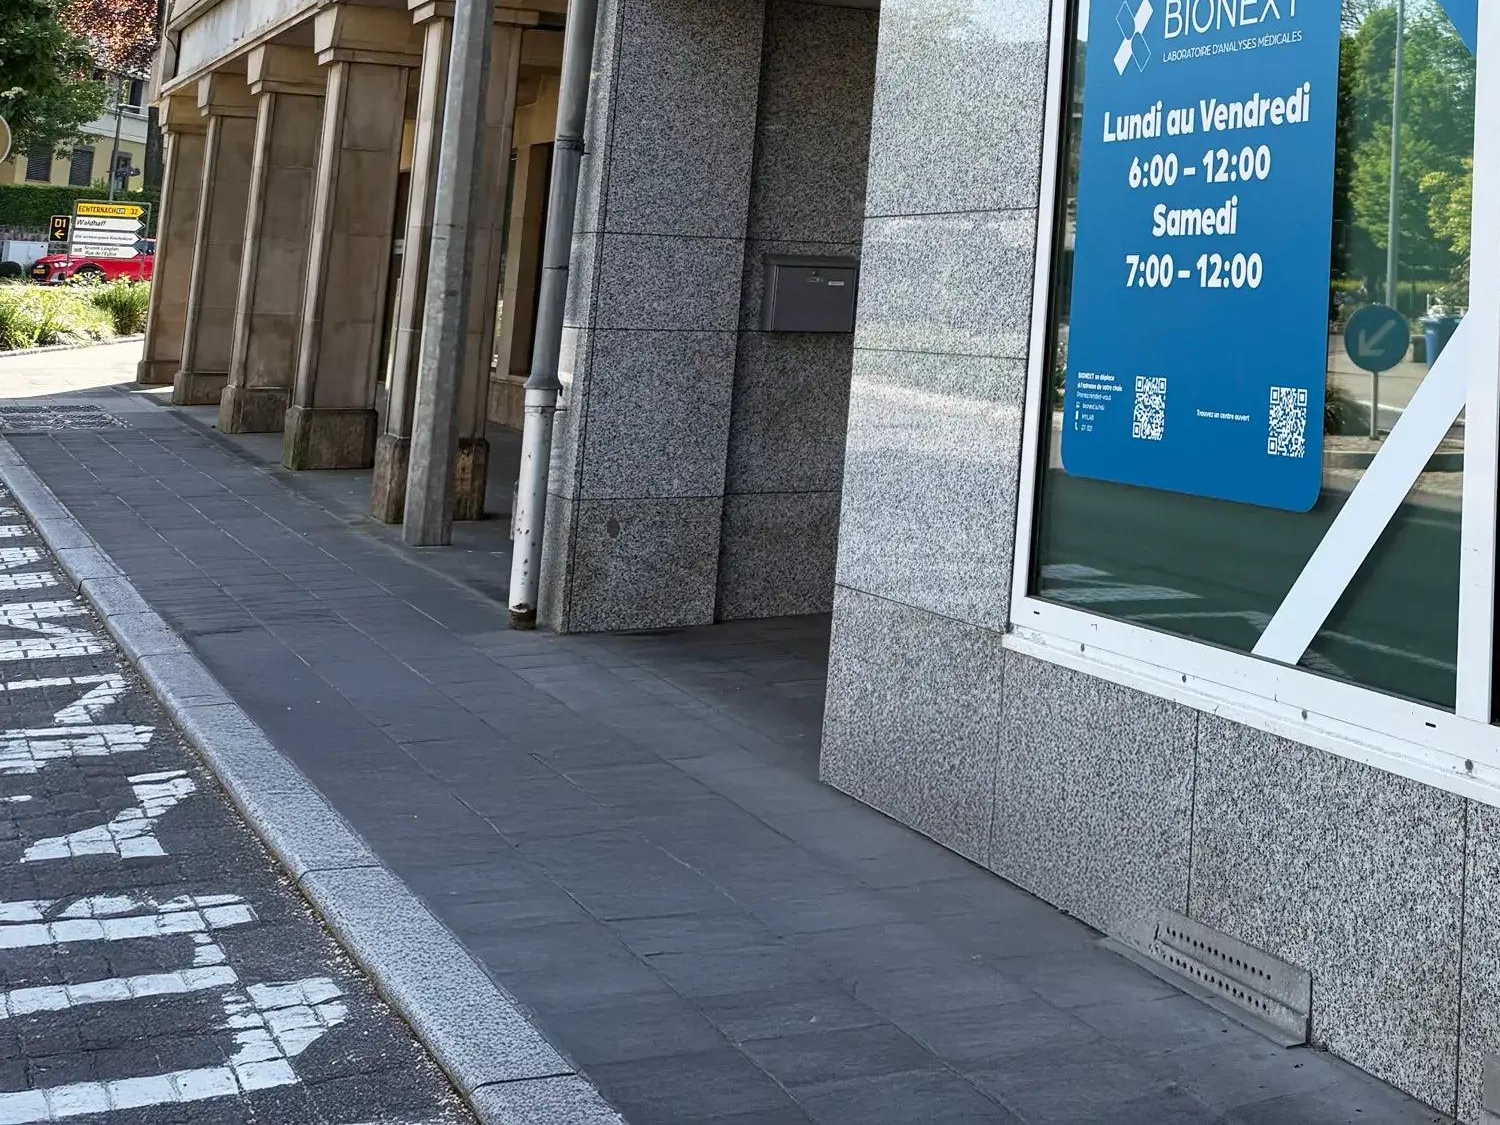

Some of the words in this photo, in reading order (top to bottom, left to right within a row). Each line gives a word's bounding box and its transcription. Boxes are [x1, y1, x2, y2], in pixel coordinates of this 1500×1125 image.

[1163, 44, 1211, 62] LABORATOIRE
[1213, 38, 1257, 55] D'ANALYSES
[1257, 30, 1302, 48] MÉDICALES
[1103, 100, 1162, 142] Lundi
[1167, 107, 1195, 136] au
[1200, 81, 1311, 132] Vendredi
[1129, 152, 1178, 188] 6:00
[1202, 144, 1271, 183] 12:00
[79, 206, 116, 214] ECHTERNACH
[1152, 195, 1238, 237] Samedi
[1126, 253, 1174, 288] 7:00
[1196, 252, 1263, 289] 12:00
